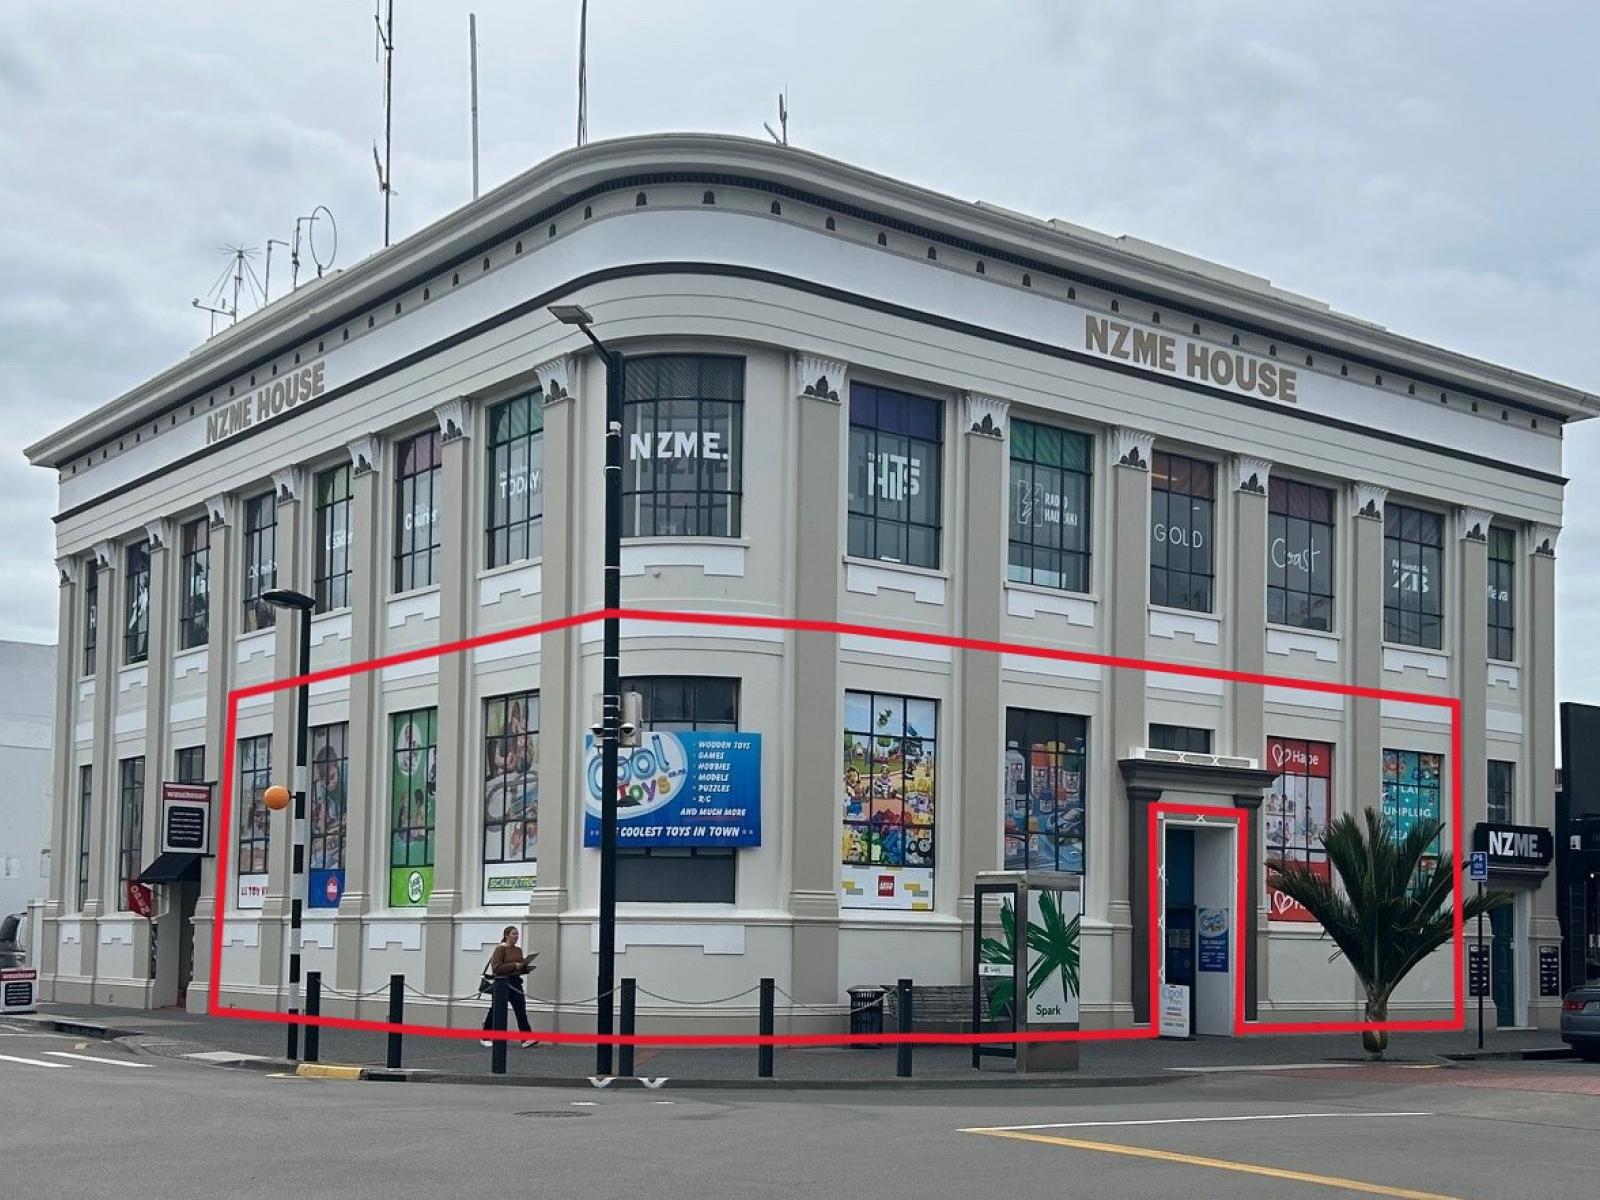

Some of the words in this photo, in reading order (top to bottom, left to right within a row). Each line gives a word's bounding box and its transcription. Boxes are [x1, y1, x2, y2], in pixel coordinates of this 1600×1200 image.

[1086, 315, 1176, 372] NZME
[1187, 343, 1297, 404] HOUSE
[206, 395, 252, 445] NZME
[256, 361, 325, 422] HOUSE
[630, 431, 729, 461] NZME.
[499, 472, 539, 499] TODAY
[1045, 493, 1068, 509] RADO
[1045, 508, 1078, 526] HAUAKI
[1153, 523, 1203, 548] GOLD
[1271, 538, 1321, 573] Coast
[698, 740, 732, 749] WOODEN
[733, 741, 751, 749] TOYS
[698, 762, 731, 771] HOBBIES
[698, 773, 729, 782] MODELS
[698, 784, 730, 792] PUZZLES
[680, 808, 697, 816] AND
[699, 808, 723, 816] MUCH
[724, 808, 747, 817] MORE
[620, 826, 663, 837] COOLEST
[665, 827, 691, 837] TOYS
[692, 827, 704, 837] IN
[709, 827, 740, 837] TOWN
[1489, 831, 1543, 858] NZME.
[1036, 1005, 1061, 1019] Spark
